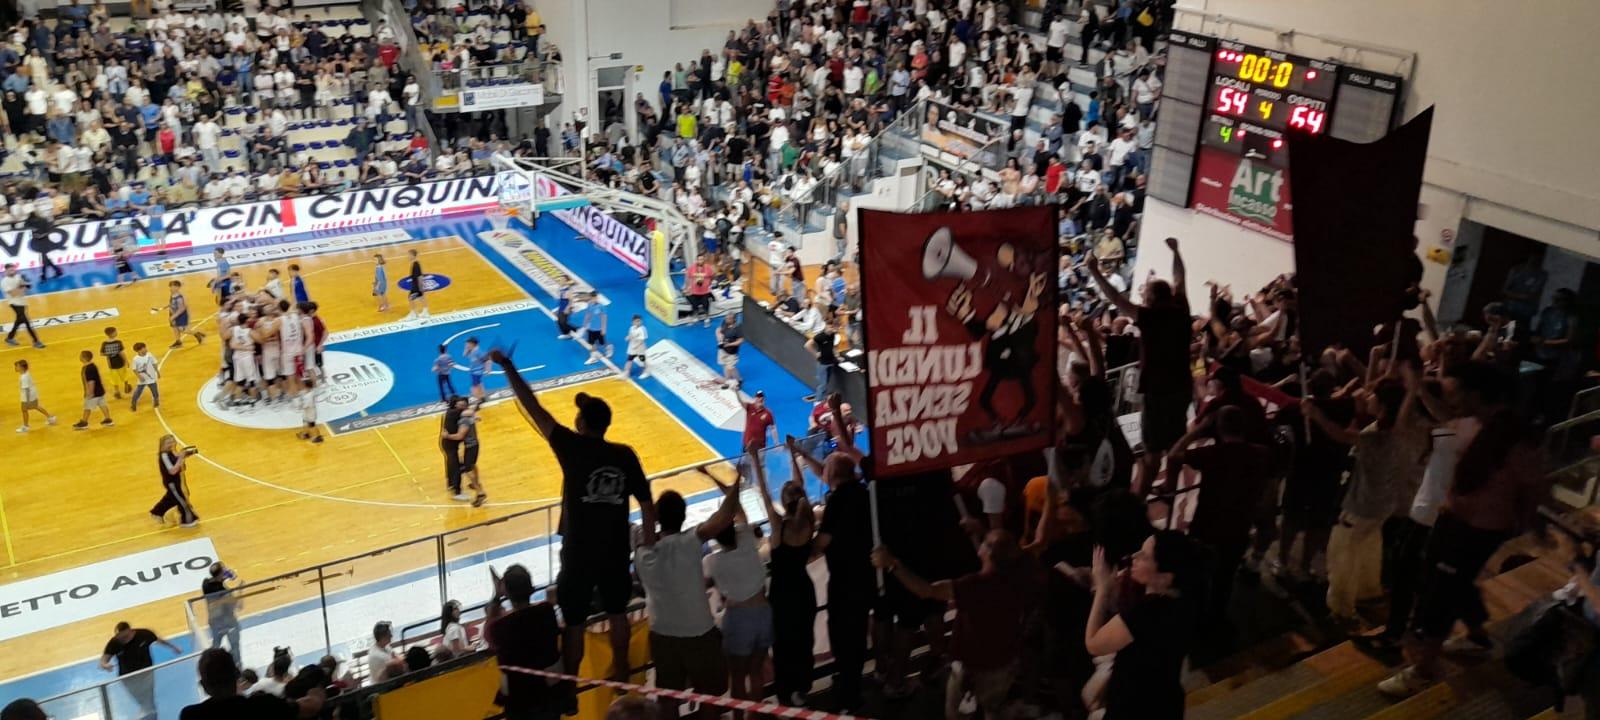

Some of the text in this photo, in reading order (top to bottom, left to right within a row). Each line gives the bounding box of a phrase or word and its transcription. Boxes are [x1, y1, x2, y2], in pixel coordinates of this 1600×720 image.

[1215, 75, 1251, 92] LOCALI
[1287, 94, 1327, 112] OSPITI
[1217, 87, 1249, 115] 54
[1259, 101, 1274, 121] 4
[1220, 126, 1233, 144] 4
[1231, 158, 1284, 202] Art
[567, 206, 648, 261] INQUINA
[331, 362, 386, 386] elli
[0, 555, 214, 618] ETTO AUTO
